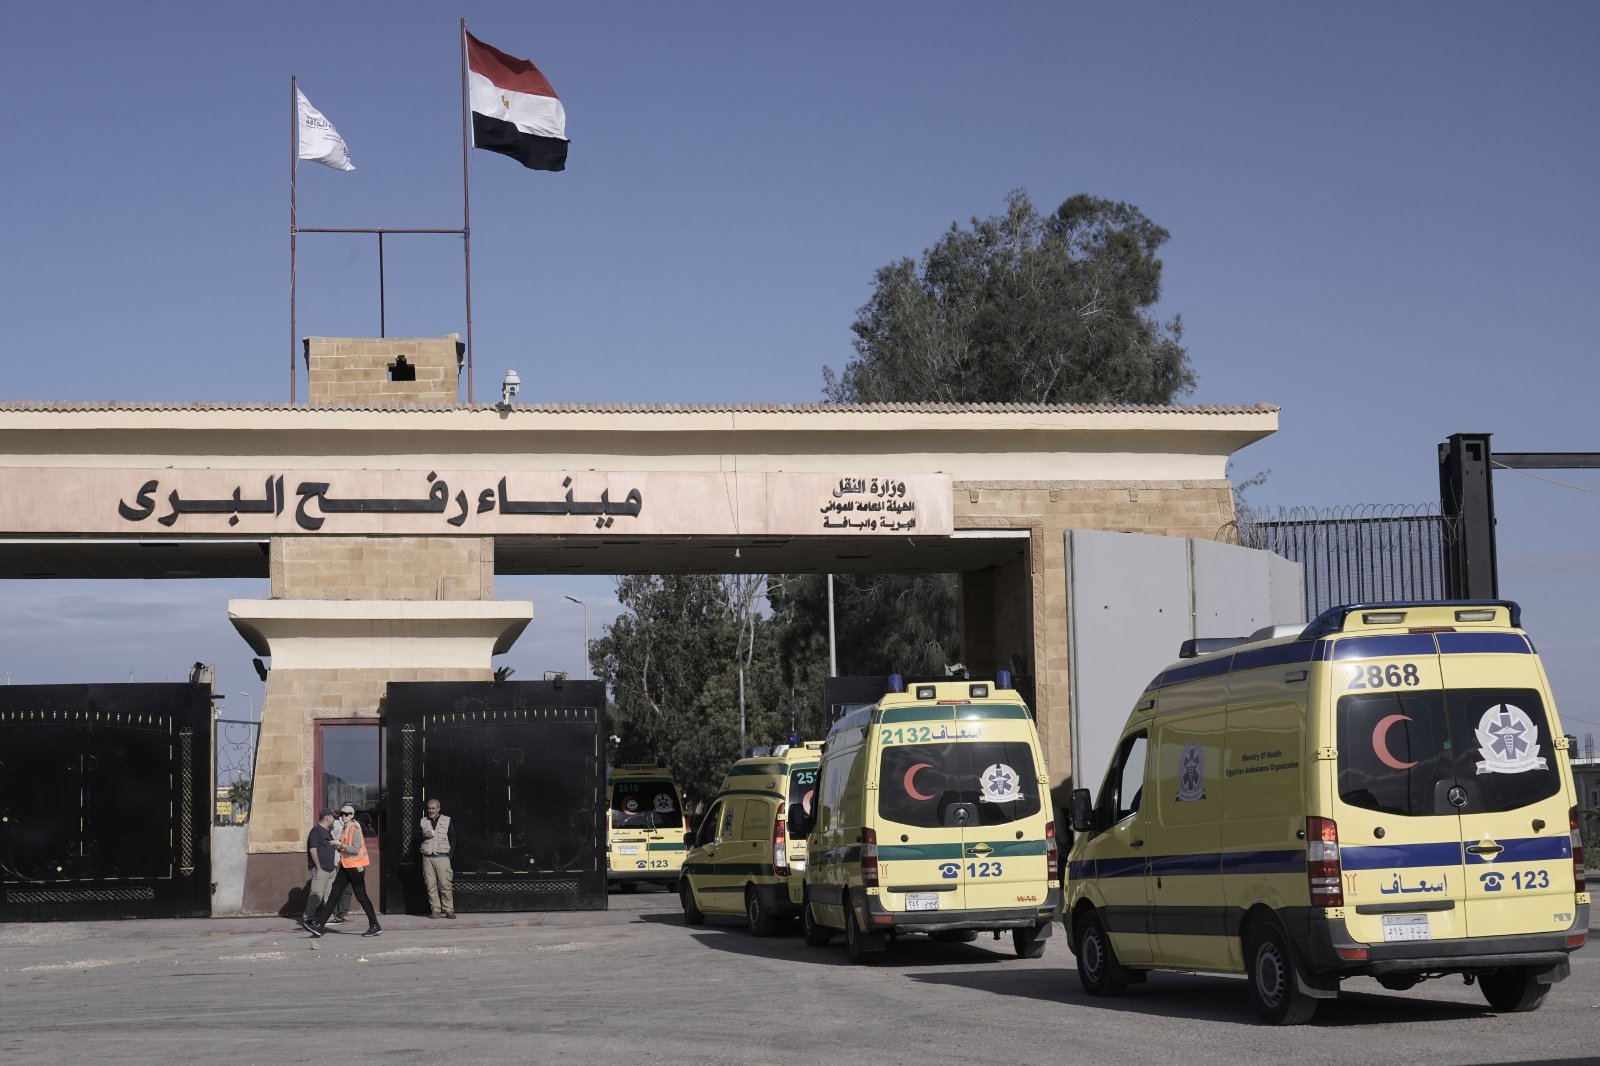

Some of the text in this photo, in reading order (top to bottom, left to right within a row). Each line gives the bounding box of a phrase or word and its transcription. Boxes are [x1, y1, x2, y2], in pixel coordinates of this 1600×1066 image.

[832, 477, 906, 498] وزارة النقل
[294, 470, 470, 531] رفح
[477, 475, 643, 529] ميناء
[1347, 663, 1420, 690] 2868
[881, 726, 931, 745] 2132
[1242, 754, 1260, 762] Ministry
[1267, 750, 1282, 758] Health
[1225, 768, 1245, 777] Egyptian
[1245, 764, 1270, 773] Ambulance
[650, 860, 669, 868] 123
[967, 862, 1003, 878] 123
[1381, 872, 1448, 897] إسعاف
[1511, 869, 1550, 890] 123
[1016, 895, 1037, 903] WAS
